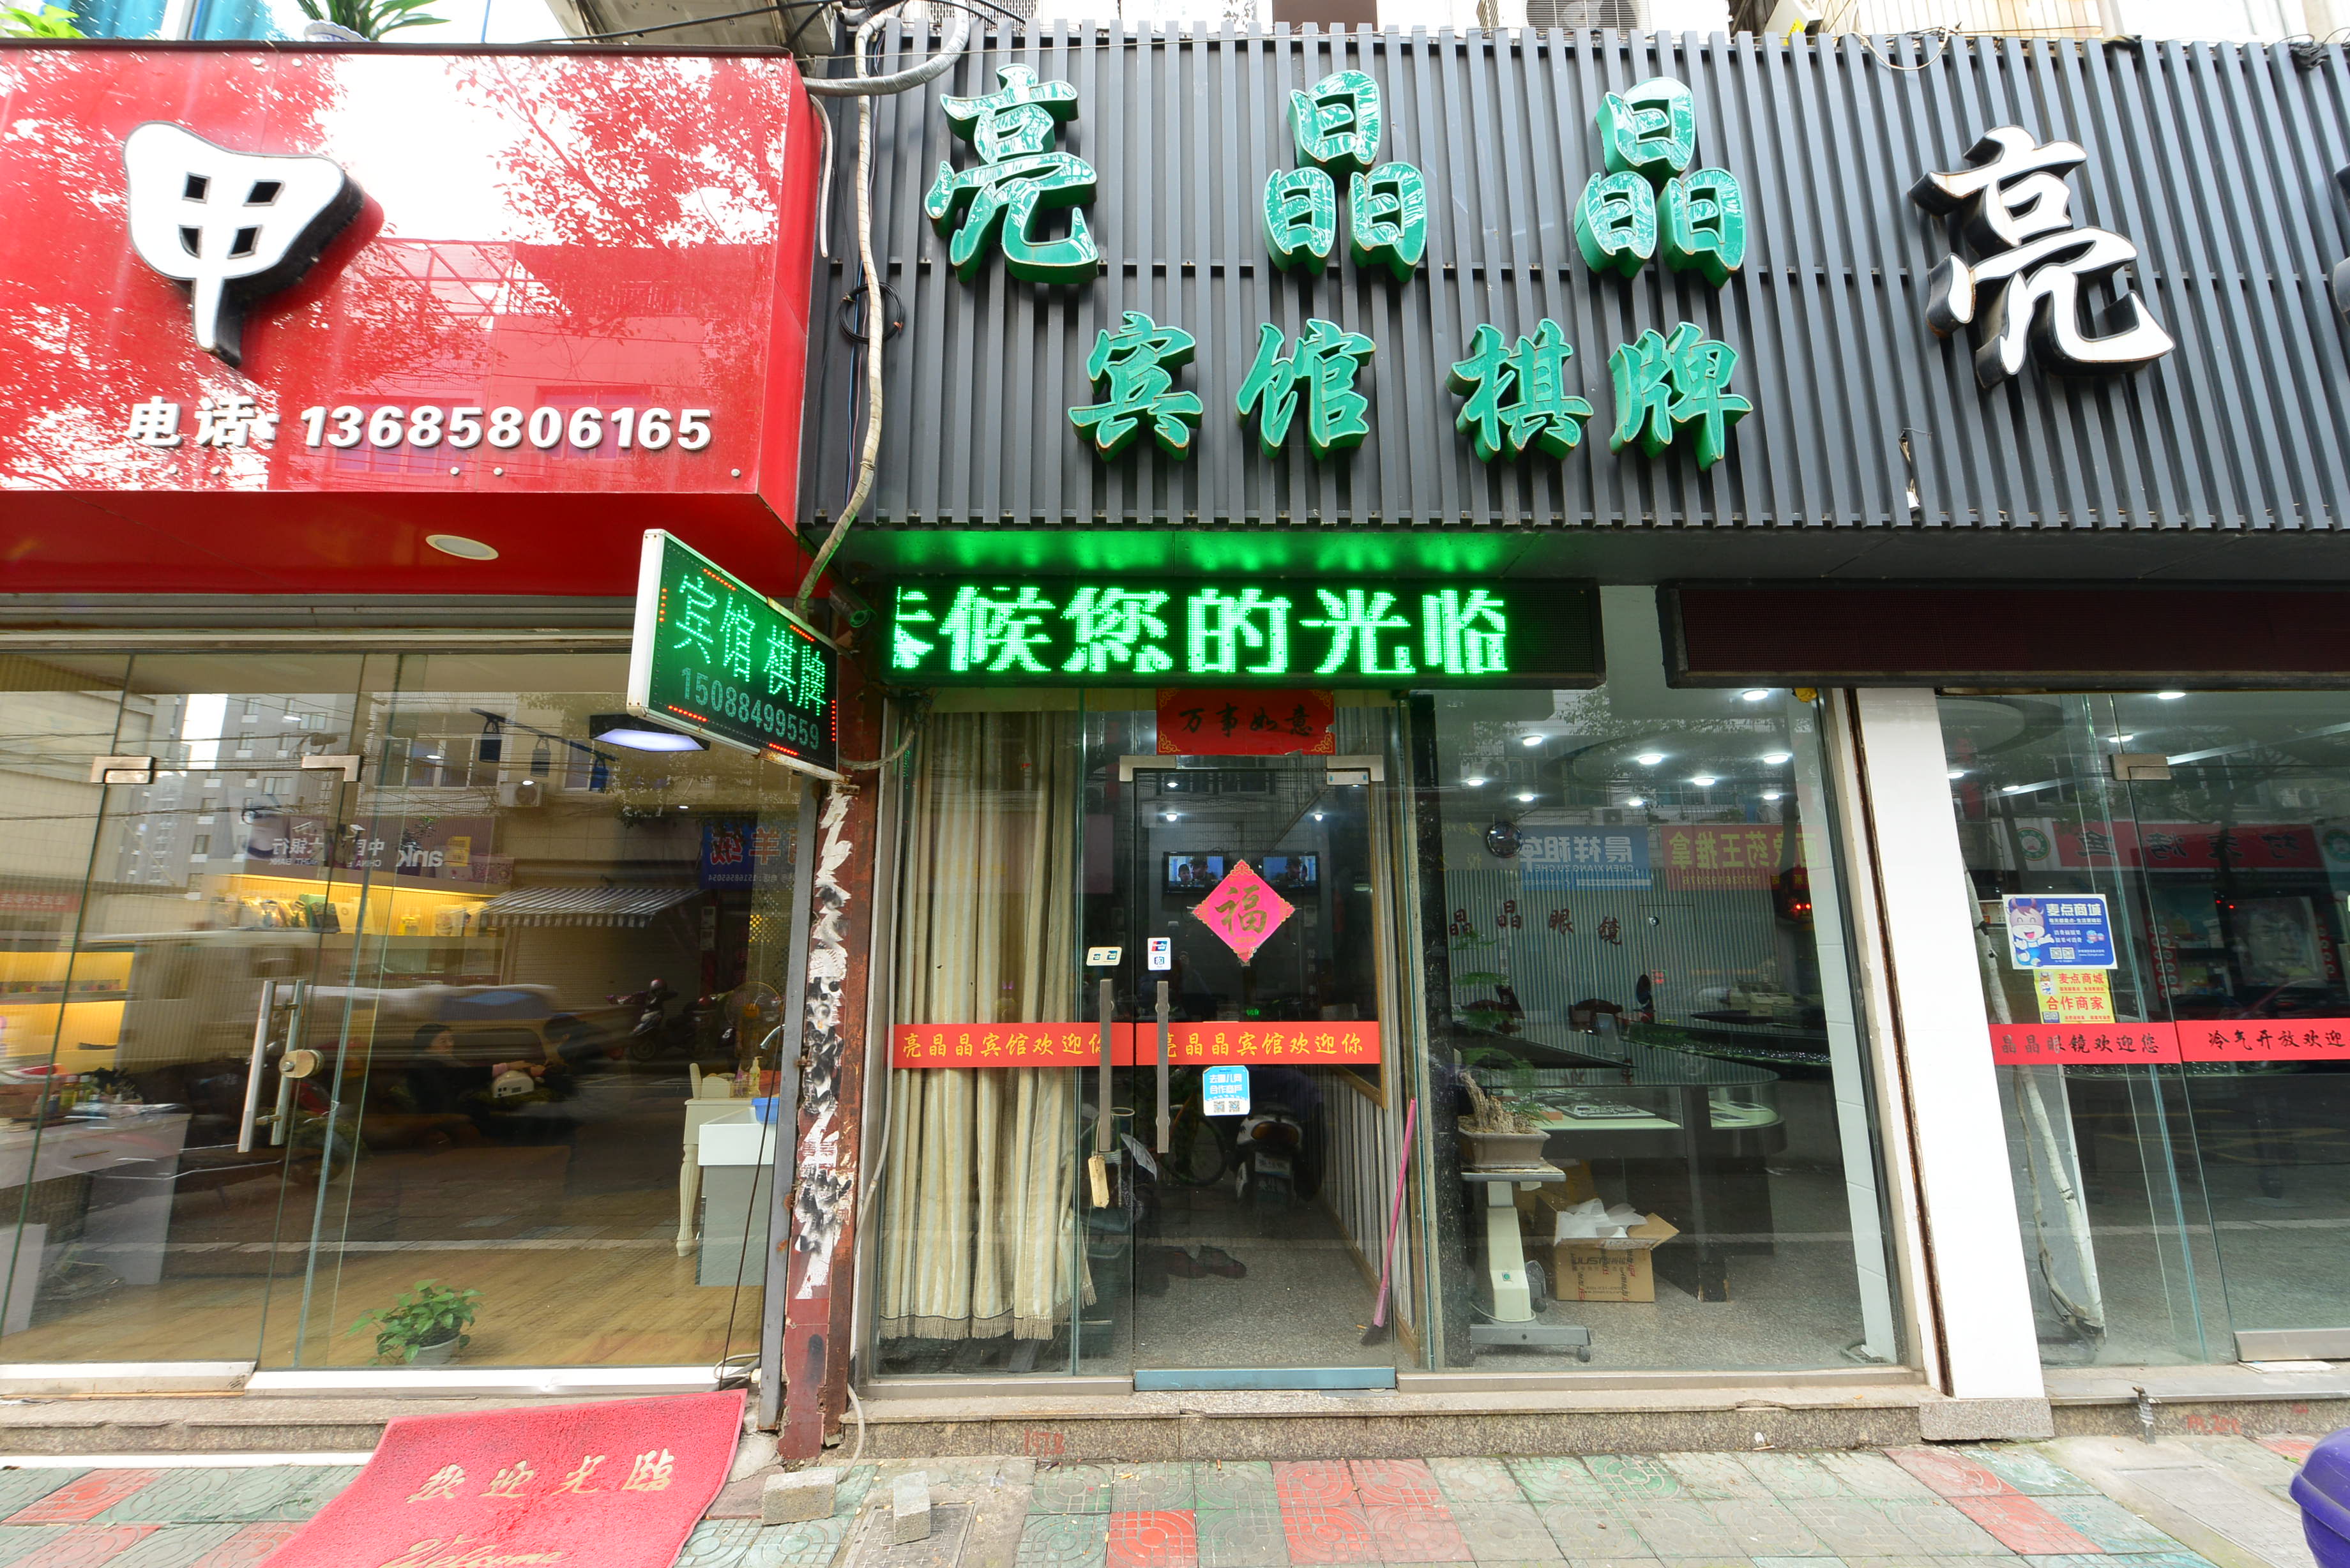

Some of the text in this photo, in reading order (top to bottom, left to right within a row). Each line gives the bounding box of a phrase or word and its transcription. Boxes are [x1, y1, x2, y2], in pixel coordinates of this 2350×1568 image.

[925, 63, 1748, 289] 亮晶晶
[124, 120, 358, 361] 甲
[1909, 124, 2175, 388] 亮
[1067, 310, 1754, 471] 宾馆 棋牌
[299, 404, 713, 451] 13685806165
[681, 667, 820, 751] 15088499559
[1179, 702, 1314, 738] 万事如意
[1215, 884, 1268, 936] 福
[1448, 899, 1623, 946] 晶晶眼镜
[2045, 903, 2102, 917] 麦点商城
[2058, 972, 2105, 984] 麦点商城
[2046, 996, 2104, 1011] 合作商家
[2208, 1029, 2350, 1051] 冷气开放欢迎
[379, 1534, 570, 1568] Welcome
